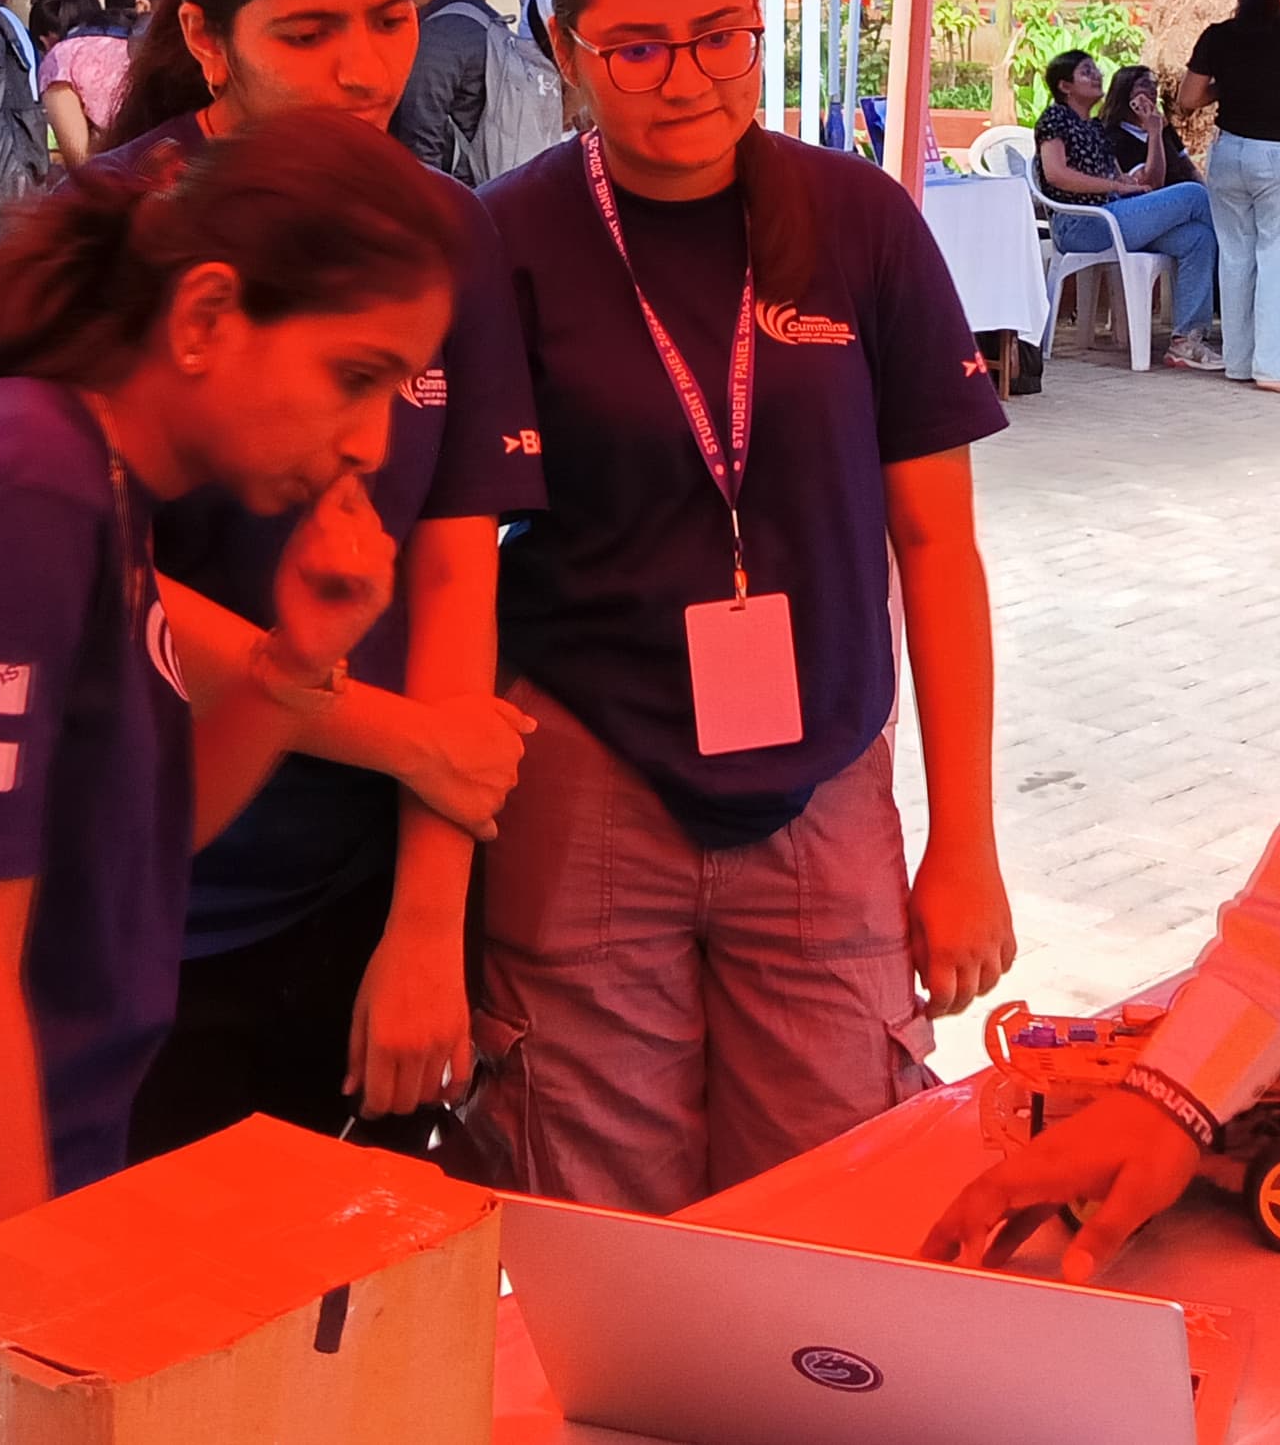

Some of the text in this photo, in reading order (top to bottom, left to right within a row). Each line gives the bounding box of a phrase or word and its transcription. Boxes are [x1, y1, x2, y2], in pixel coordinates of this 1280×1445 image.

[595, 179, 614, 218] PANEL
[786, 321, 850, 332] Cummins
[667, 349, 690, 390] PANEL
[734, 336, 750, 380] PANEL
[684, 391, 718, 455] STUDENT
[732, 381, 747, 449] STUDENT
